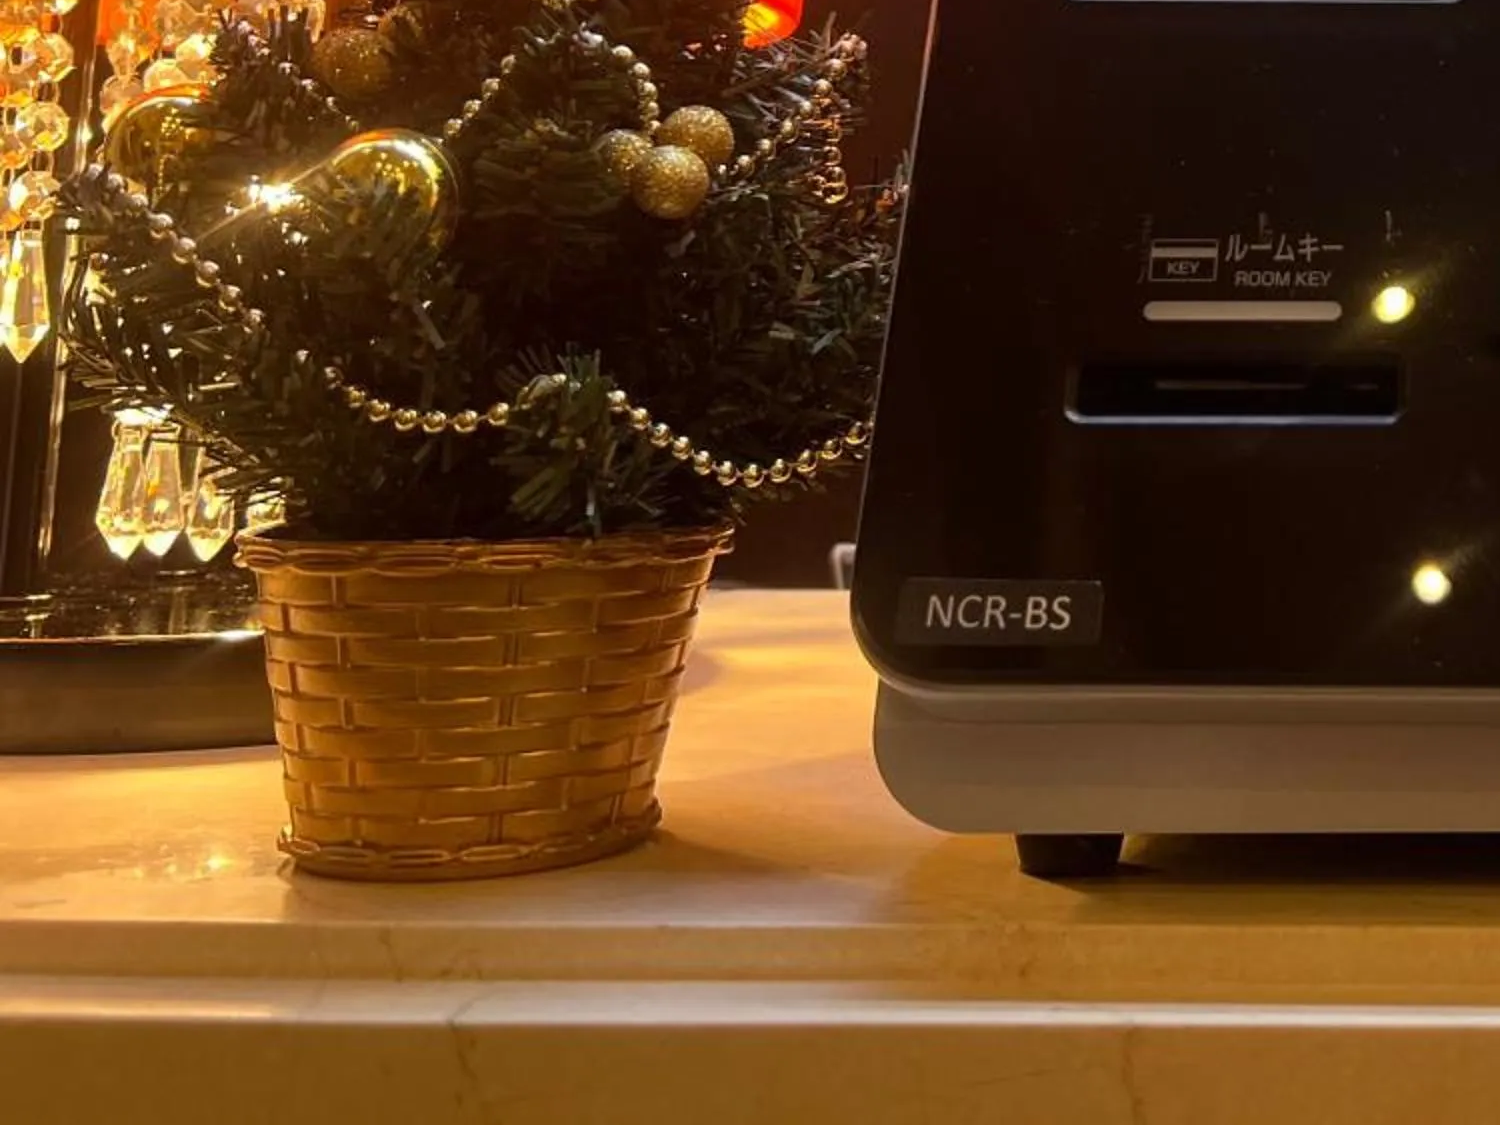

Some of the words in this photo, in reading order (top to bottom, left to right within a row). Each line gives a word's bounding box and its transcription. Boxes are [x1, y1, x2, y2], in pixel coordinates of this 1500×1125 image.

[1224, 232, 1345, 263] ルームキー
[1166, 260, 1201, 275] KEY
[1235, 271, 1291, 287] ROOM
[1296, 270, 1333, 287] KEY
[926, 594, 1072, 631] NCR-BS
